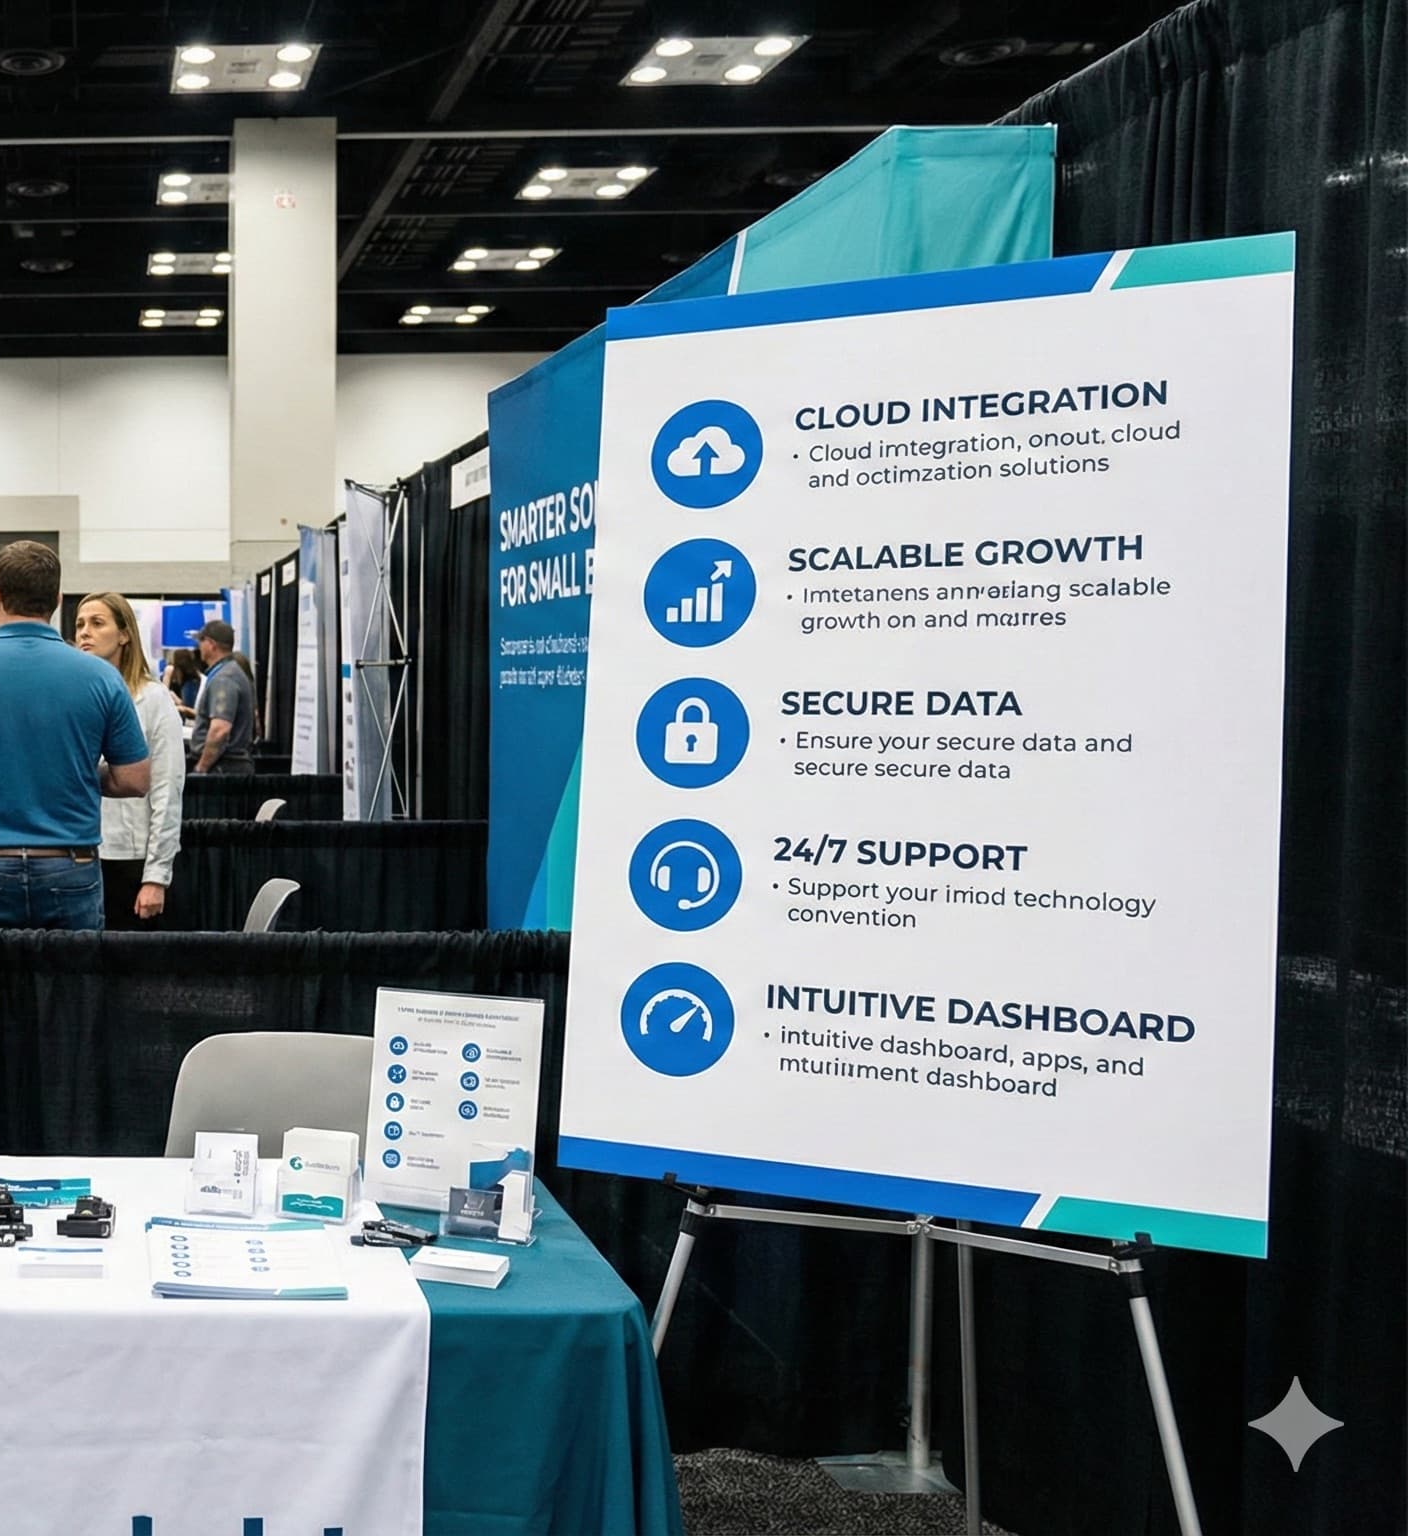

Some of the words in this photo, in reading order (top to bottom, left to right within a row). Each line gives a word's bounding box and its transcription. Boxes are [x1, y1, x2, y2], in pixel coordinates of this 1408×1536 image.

[795, 400, 911, 431] CLOUD
[922, 379, 1168, 423] INTEGRATION
[809, 441, 872, 463] Cloud
[1111, 419, 1180, 444] cloud
[808, 468, 849, 489] and
[856, 460, 992, 486] octimzation
[999, 454, 1110, 478] solutions
[500, 491, 566, 552] SMARTER
[788, 542, 965, 572] SCALABLE
[975, 534, 1143, 566] GROWTH
[500, 564, 527, 608] FOR
[529, 551, 581, 602] SMALL
[1069, 576, 1171, 598] scalable
[801, 611, 881, 635] growth
[887, 614, 916, 629] on
[924, 609, 968, 628] and
[781, 690, 915, 716] SECURE
[926, 690, 1023, 717] DATA
[796, 731, 873, 750] Ensure
[877, 735, 931, 754] your
[936, 736, 1016, 751] secure
[1022, 732, 1076, 752] data
[1084, 733, 1132, 753] and
[794, 761, 868, 777] secure
[874, 763, 952, 778] secure
[957, 759, 1011, 780] data
[773, 833, 848, 866] 24/7
[856, 839, 1029, 871] SUPPORT
[788, 877, 880, 901] Support
[885, 886, 939, 905] your
[1013, 889, 1157, 919] technology
[787, 907, 916, 928] convention
[767, 983, 936, 1023] INTUITIVE
[947, 998, 1196, 1043] DASHBOARD
[781, 1025, 874, 1052] intuitive
[880, 1034, 1014, 1068] dashboard,
[1022, 1051, 1088, 1075] apps,
[1096, 1056, 1144, 1077] and
[926, 1066, 1057, 1097] dashboard
